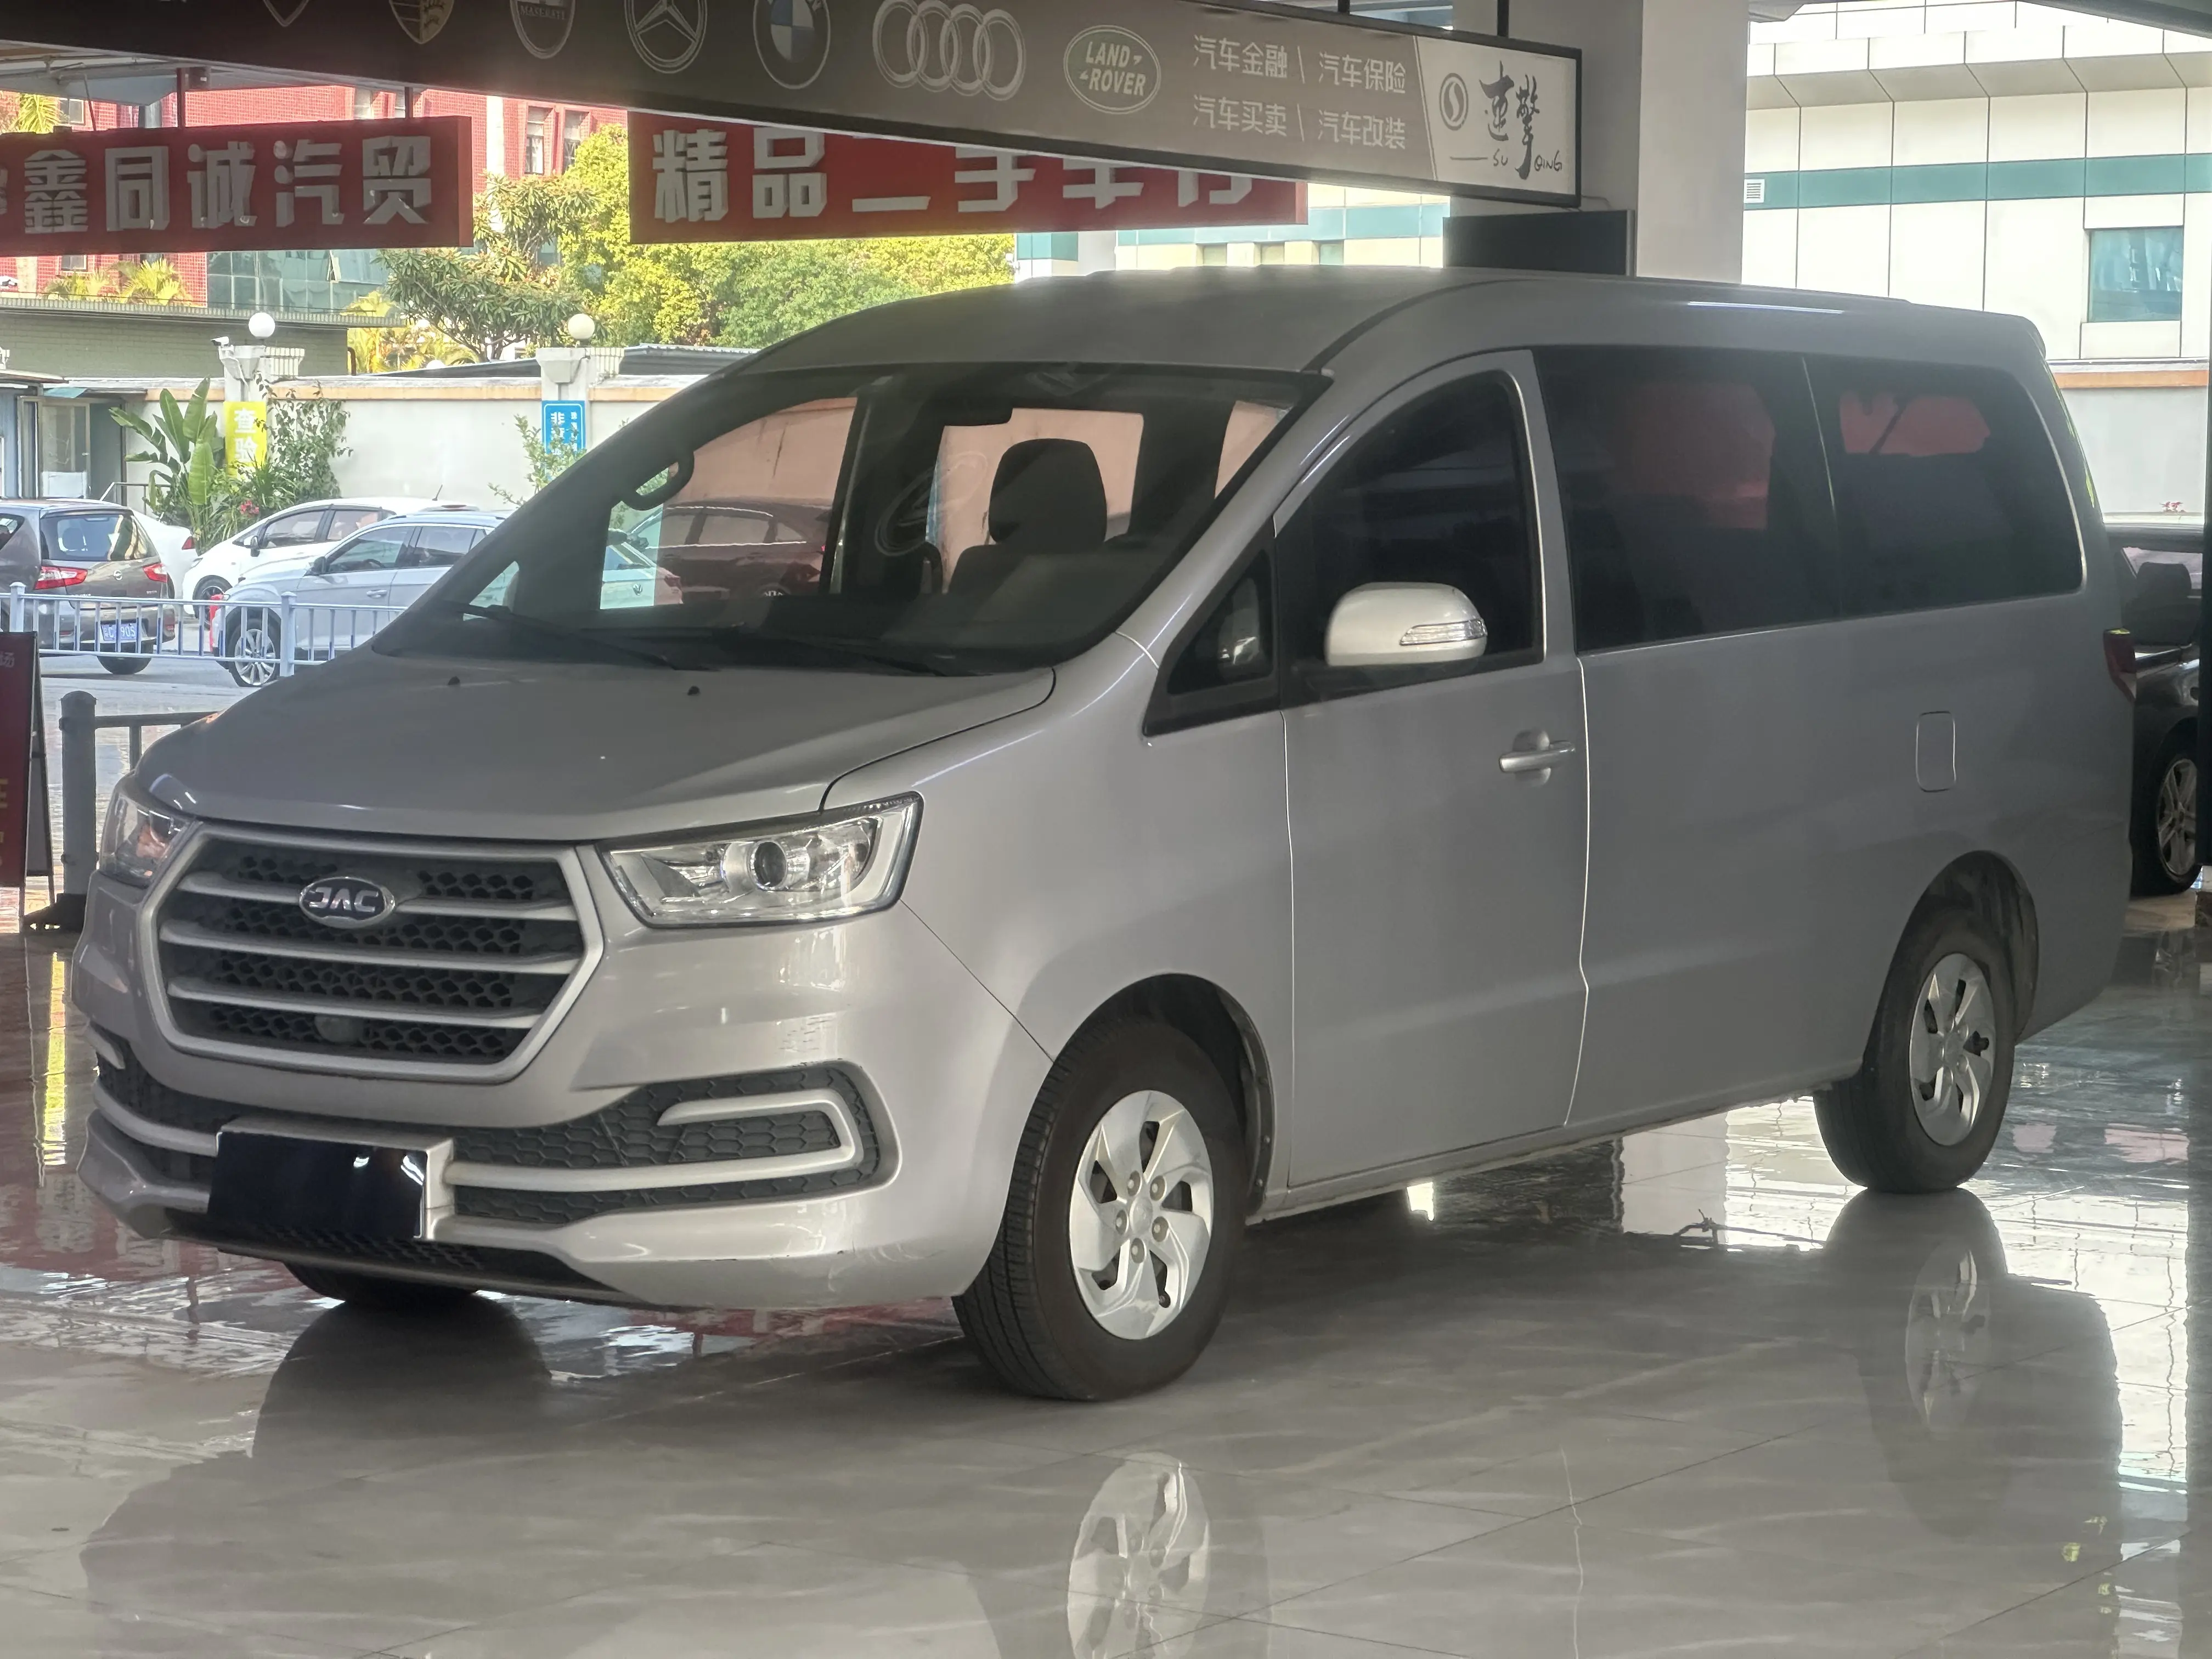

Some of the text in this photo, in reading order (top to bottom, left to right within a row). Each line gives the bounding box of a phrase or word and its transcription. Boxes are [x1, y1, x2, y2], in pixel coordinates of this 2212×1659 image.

[1086, 41, 1130, 67] LAND
[1194, 35, 1406, 93] 汽车金融 汽车保险
[1089, 68, 1146, 96] ROVER
[1193, 94, 1406, 149] 汽车买卖 汽车改装
[1493, 148, 1562, 172] SU QING
[0, 136, 431, 234] 鑫同诚汽贸
[309, 887, 379, 912] JAC
